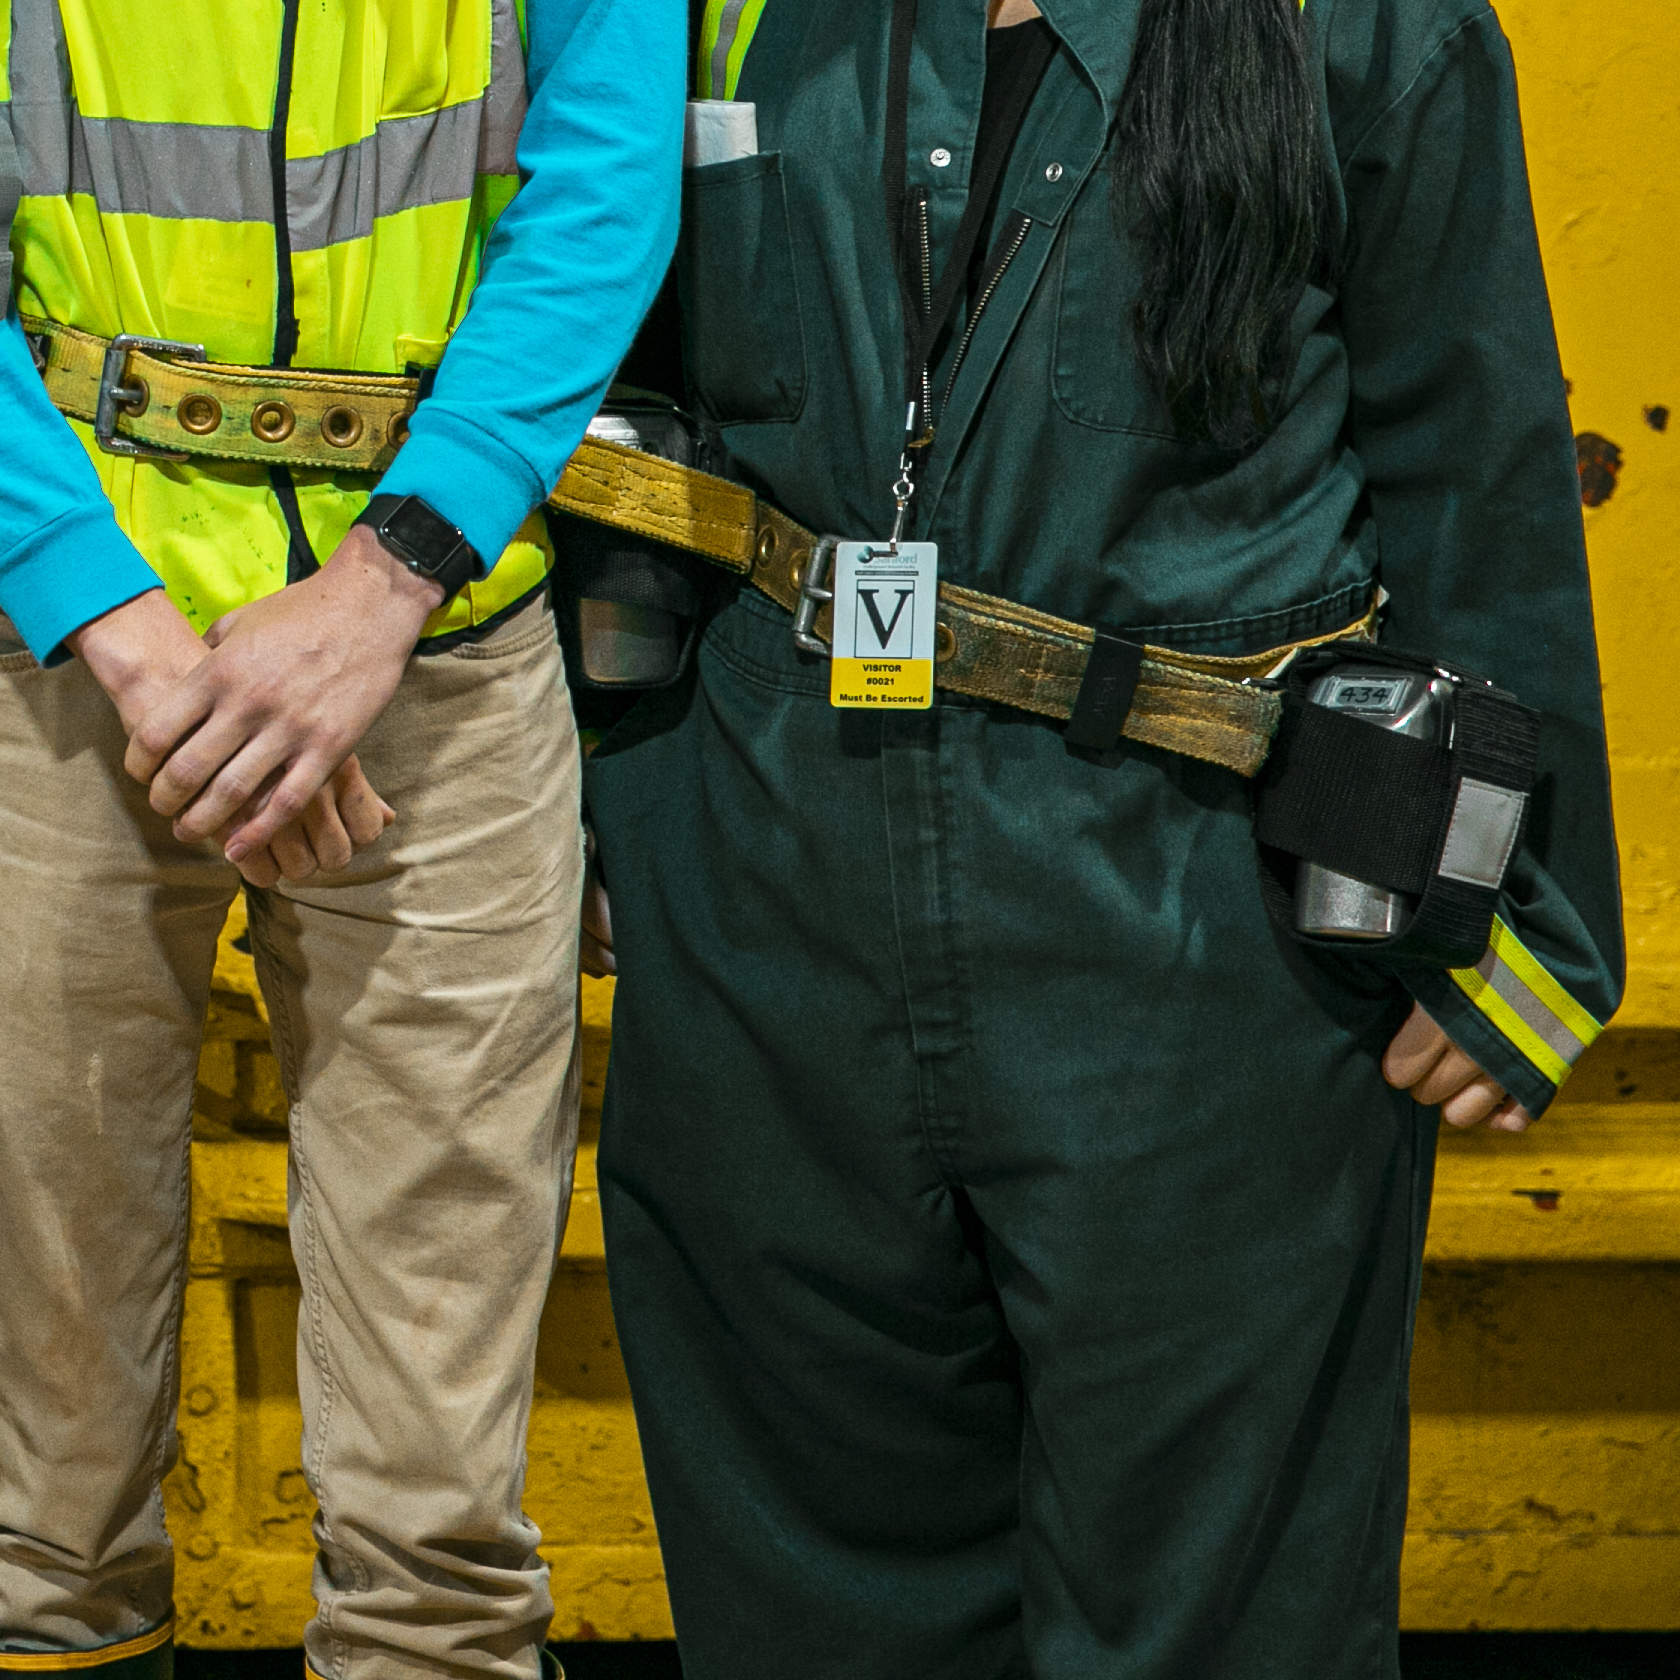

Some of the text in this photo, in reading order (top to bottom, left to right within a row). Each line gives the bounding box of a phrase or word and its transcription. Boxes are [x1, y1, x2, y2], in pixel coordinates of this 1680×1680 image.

[856, 588, 915, 650] V
[862, 664, 902, 673] VISITOR
[866, 677, 895, 686] #0021
[839, 693, 924, 703] Must Be Escorted
[1339, 686, 1388, 704] 434
